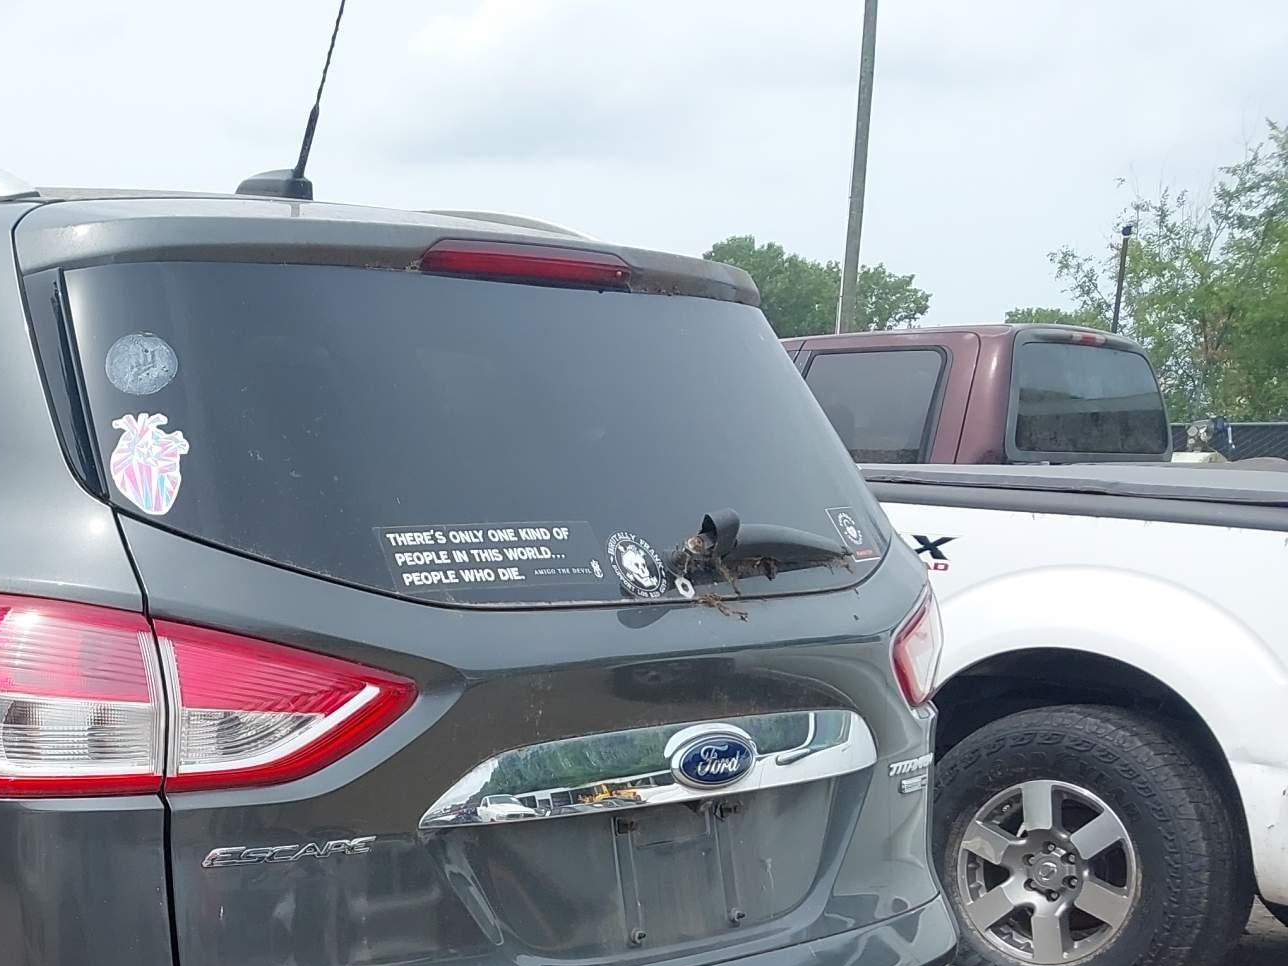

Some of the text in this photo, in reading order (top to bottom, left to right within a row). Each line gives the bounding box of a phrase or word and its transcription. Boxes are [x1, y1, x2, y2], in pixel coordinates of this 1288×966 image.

[386, 527, 569, 546] THERE'S ONLY ONE KIND OF
[395, 546, 565, 567] PEOPLE IN THIS WORLD...
[402, 567, 526, 586] PEOPLE WHO DIE.
[697, 744, 741, 777] Ford
[201, 835, 377, 868] ESCAPE
